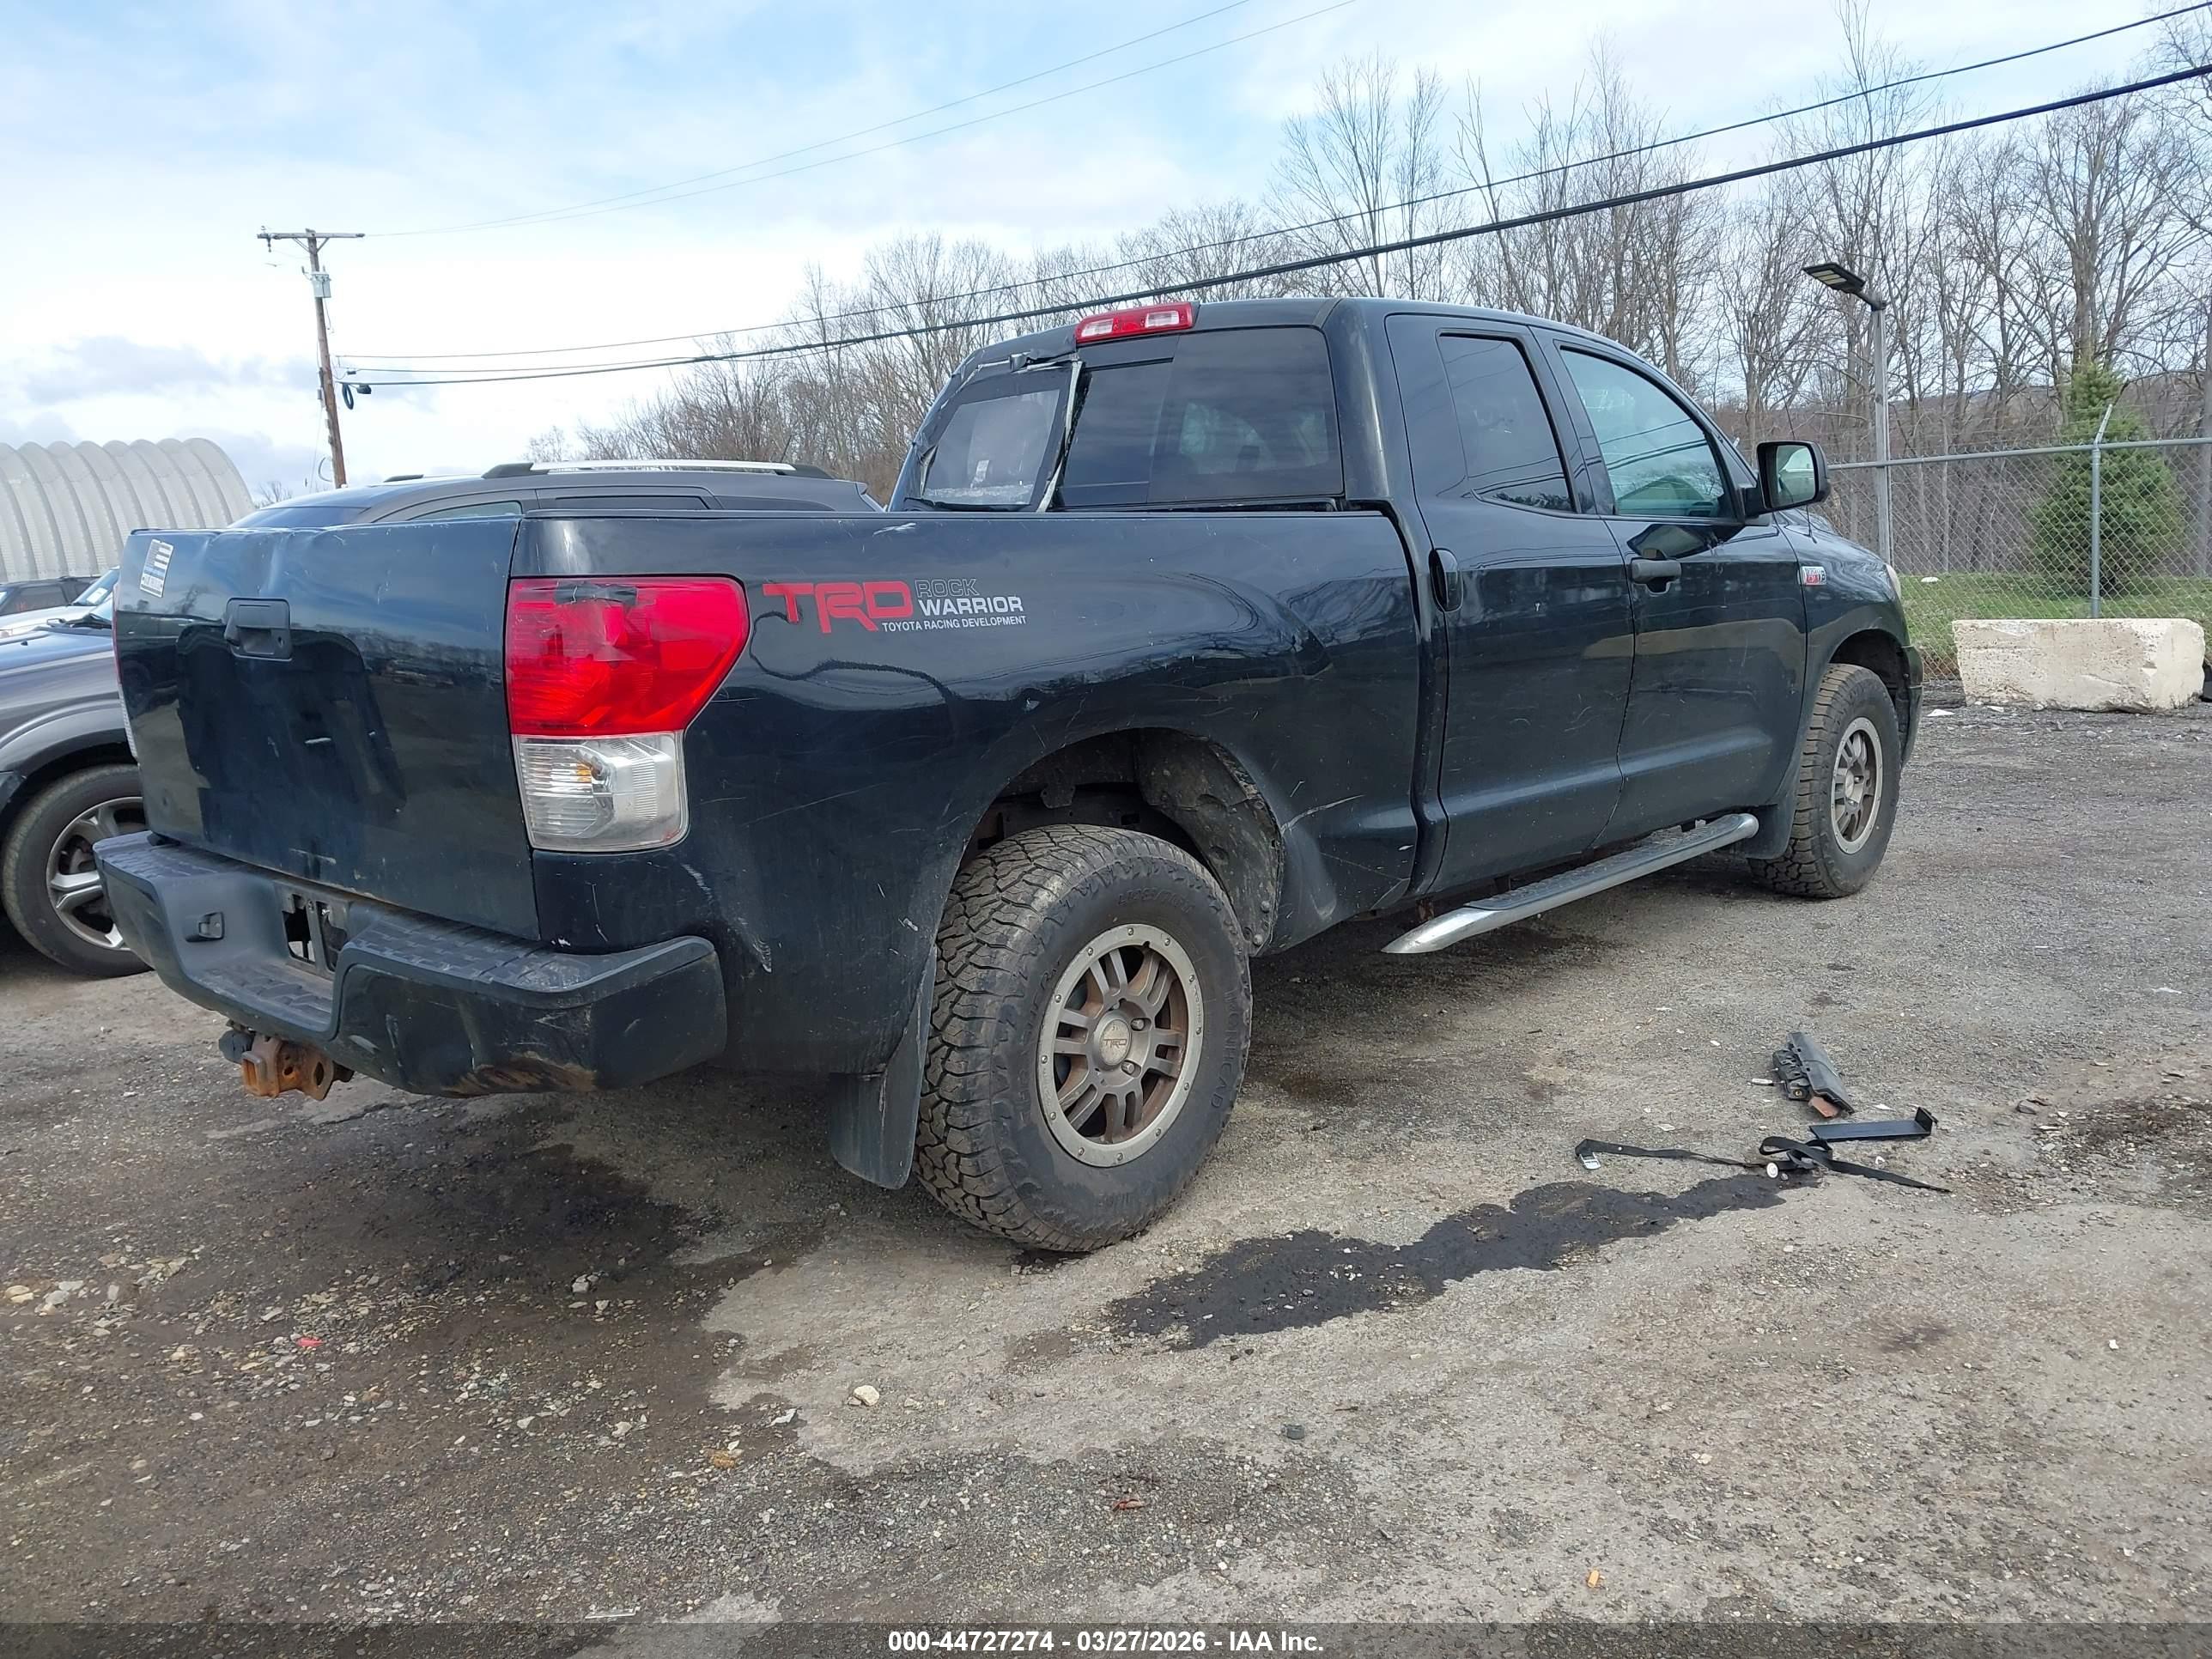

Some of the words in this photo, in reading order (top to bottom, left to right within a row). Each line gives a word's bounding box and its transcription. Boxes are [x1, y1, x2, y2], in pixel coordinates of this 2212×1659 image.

[915, 578, 980, 598] ROCK
[763, 580, 914, 634] TRD
[918, 596, 1024, 617] WARRIOR
[882, 620, 923, 633] TOYOTA
[924, 618, 960, 630] RACING
[962, 615, 1027, 629] DEVELOPMENT
[1103, 1037, 1127, 1049] TRD
